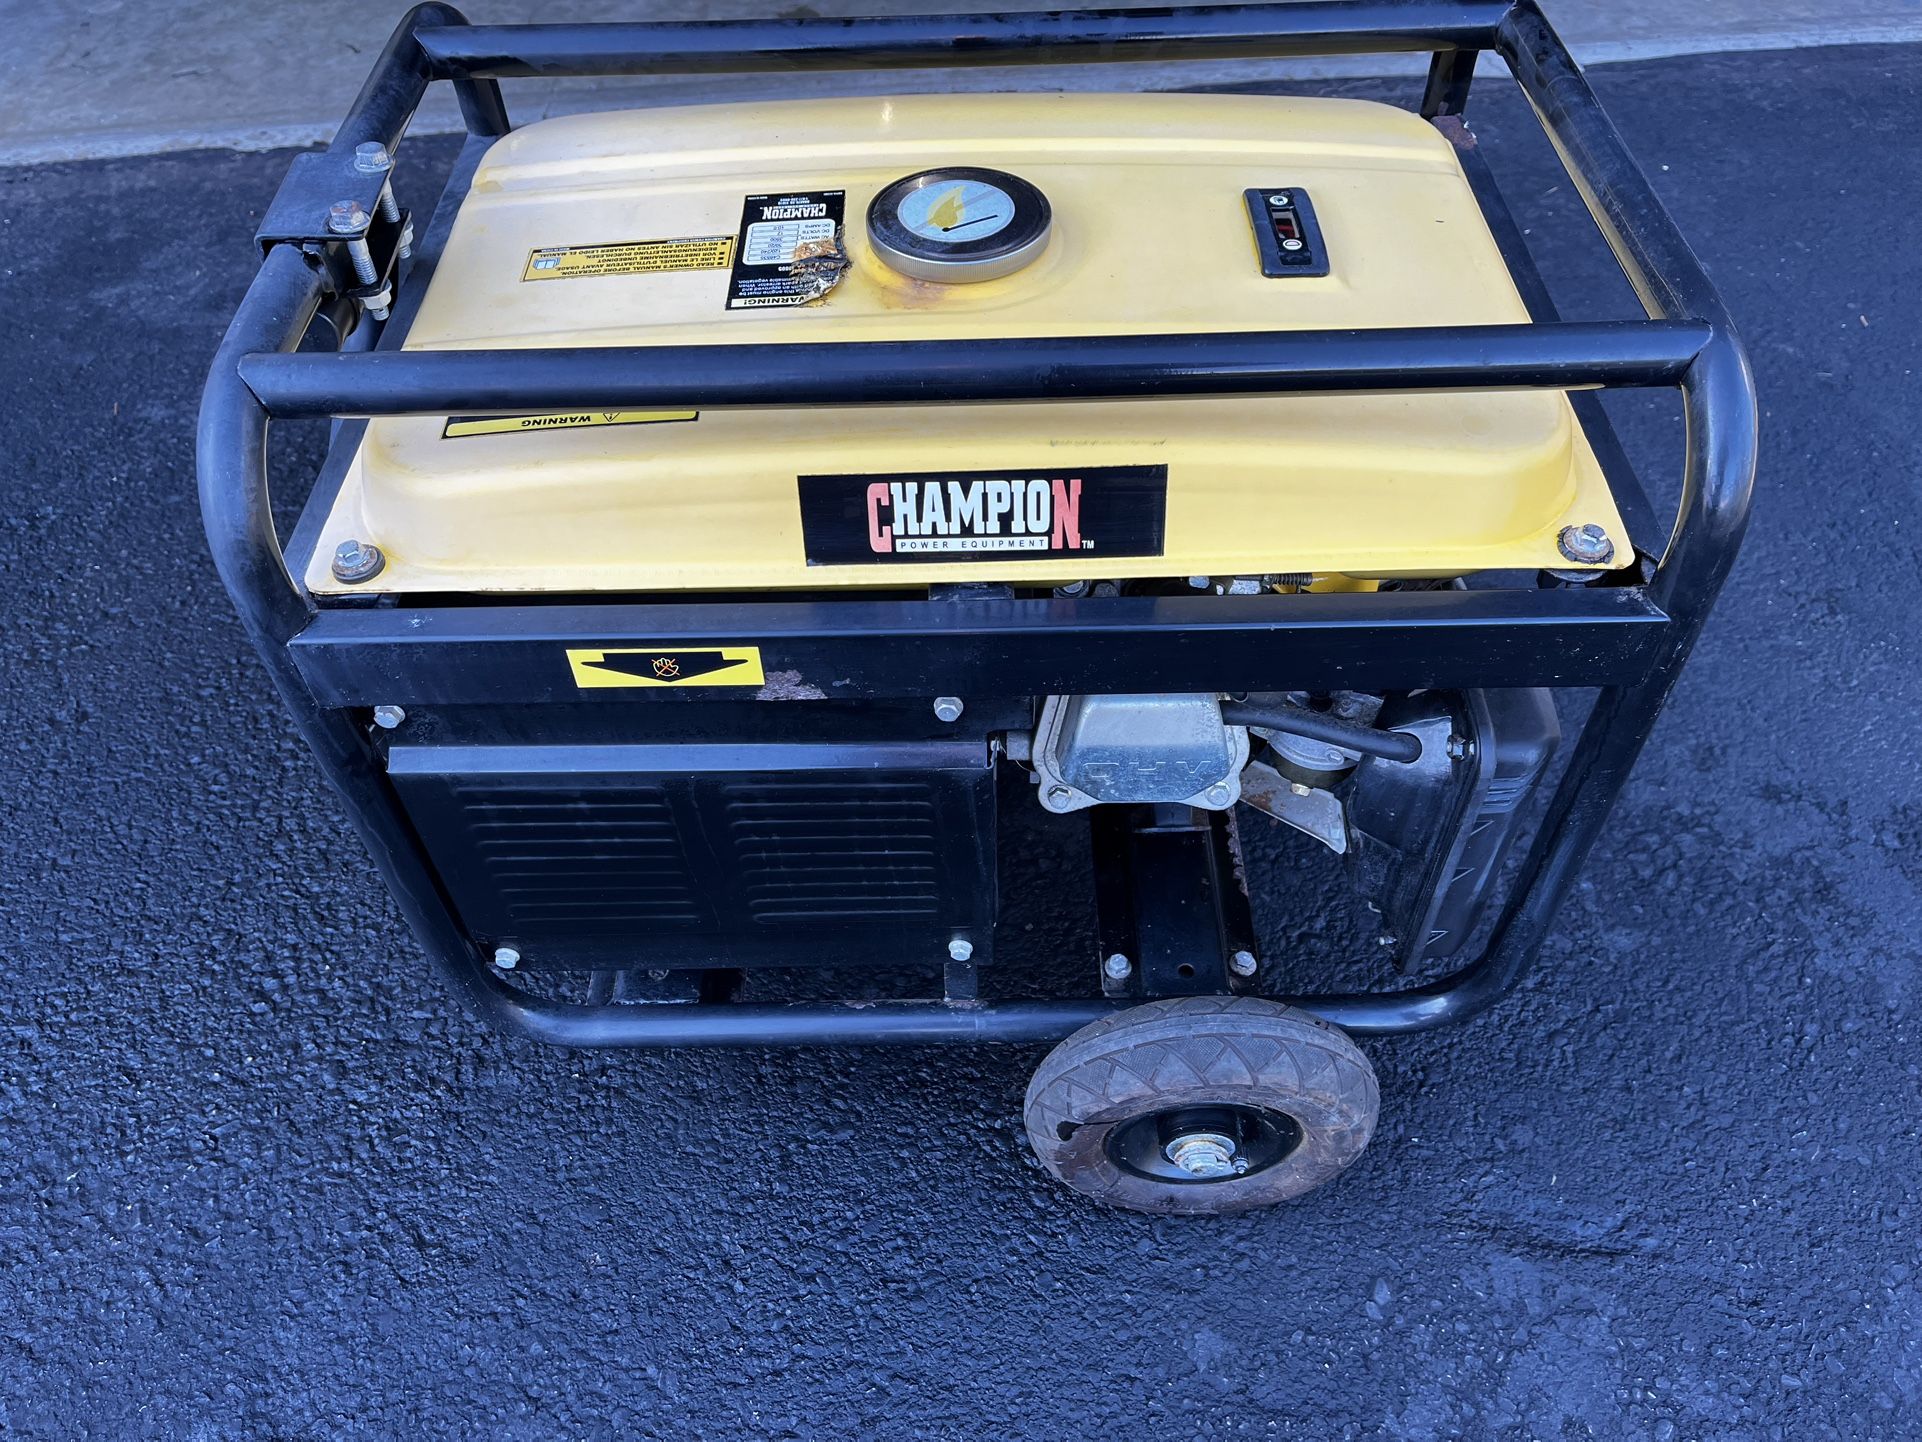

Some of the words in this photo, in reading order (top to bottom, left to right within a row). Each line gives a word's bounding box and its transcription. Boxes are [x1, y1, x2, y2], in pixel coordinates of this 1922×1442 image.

[762, 203, 827, 219] CHAMPION
[521, 416, 591, 427] WARNING
[867, 479, 1082, 552] CHAMPION
[900, 541, 949, 549] POWER
[961, 539, 1045, 549] EQUIPMENT
